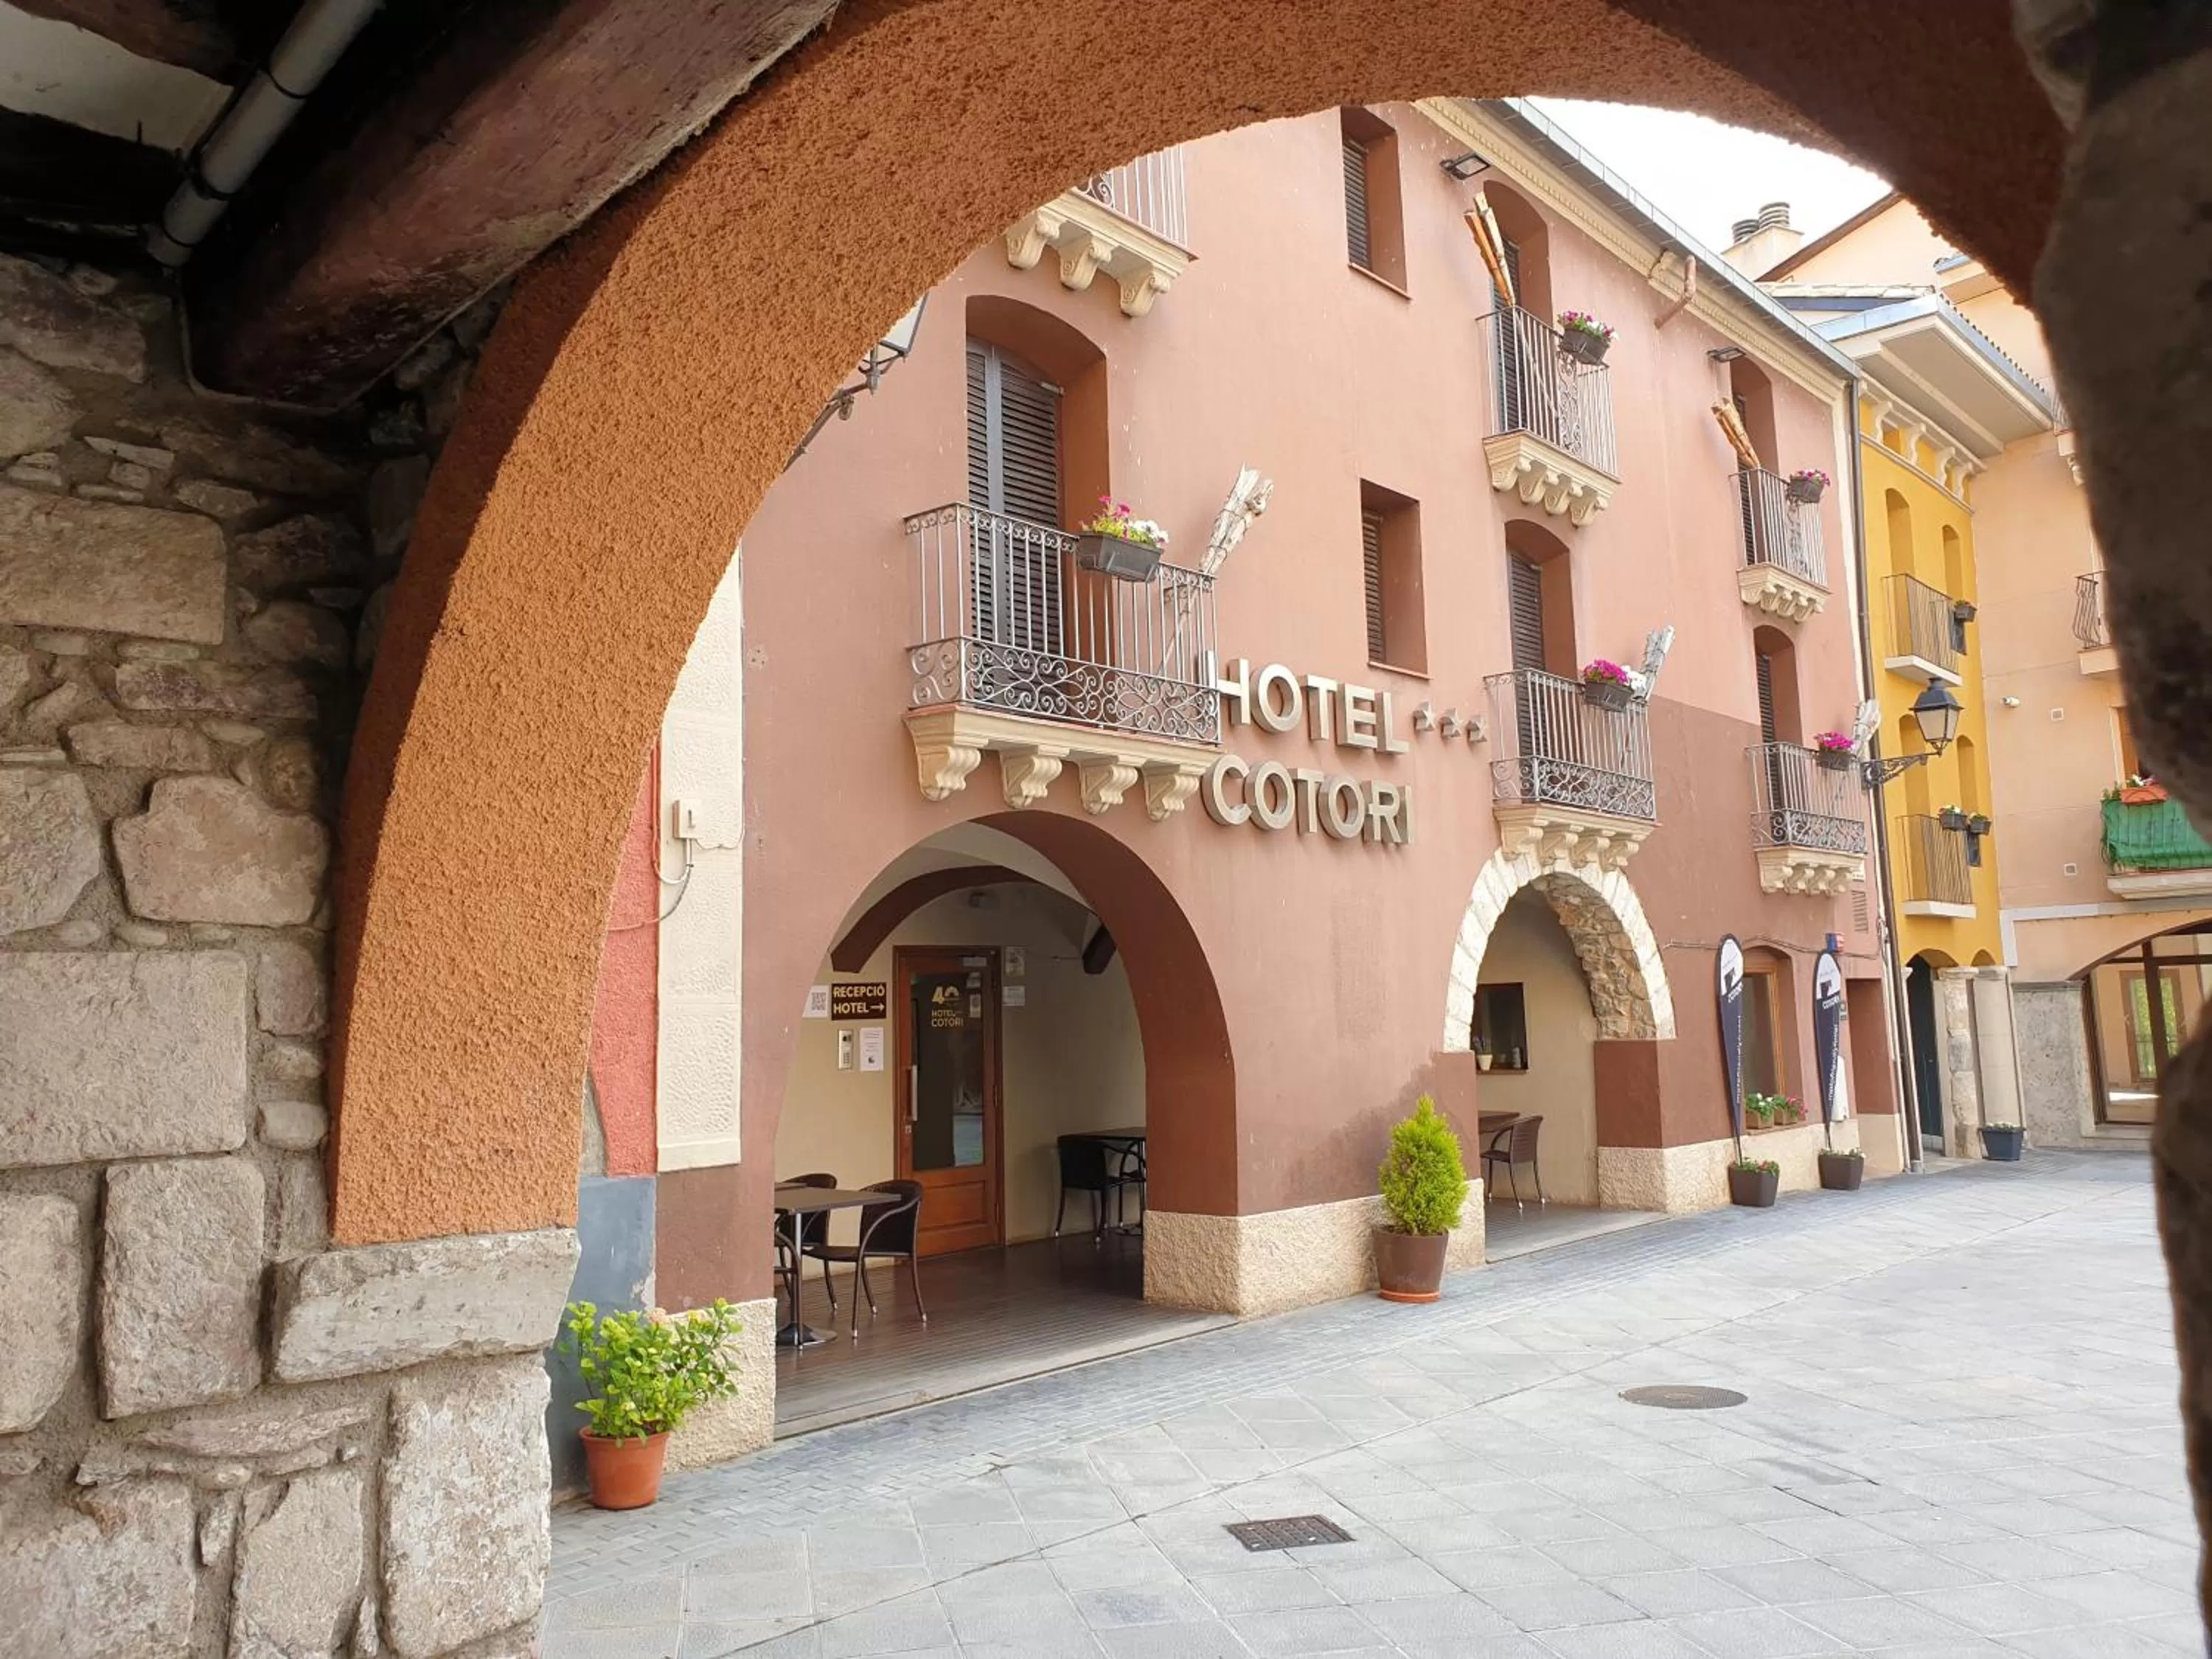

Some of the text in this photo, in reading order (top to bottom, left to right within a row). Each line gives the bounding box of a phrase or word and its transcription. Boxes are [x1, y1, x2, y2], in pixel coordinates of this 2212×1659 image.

[1205, 650, 1410, 754] HOTEL
[1201, 754, 1413, 845] COTORI
[833, 984, 885, 998] RECEPCIÓ
[833, 1002, 869, 1015] HOTEL
